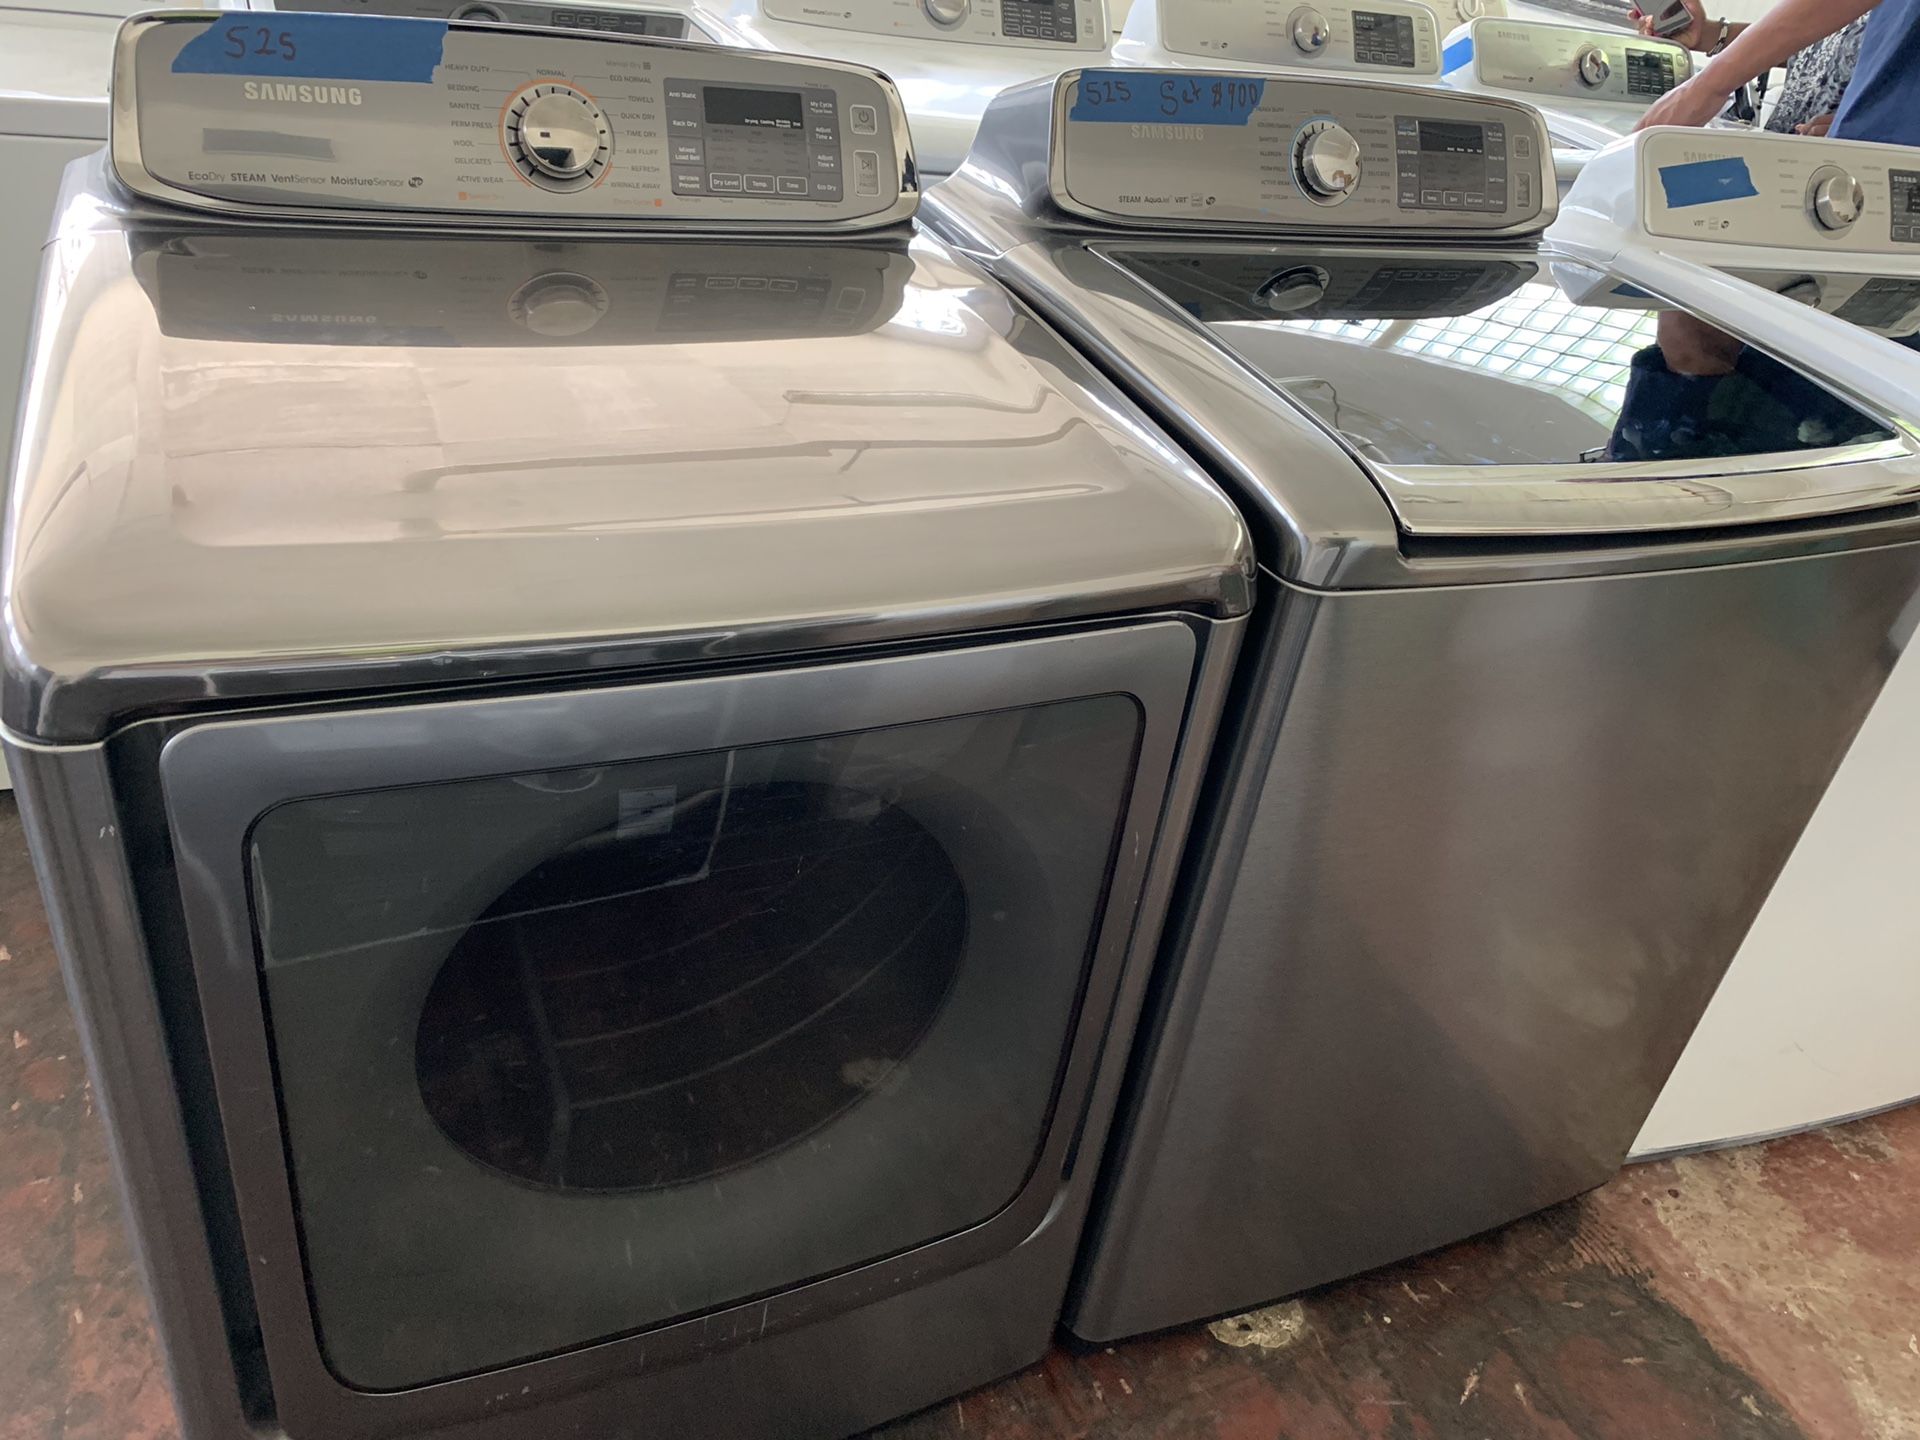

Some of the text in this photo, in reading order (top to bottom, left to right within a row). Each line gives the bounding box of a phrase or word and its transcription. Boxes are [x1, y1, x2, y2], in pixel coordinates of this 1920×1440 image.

[471, 65, 490, 73] DUTY
[536, 68, 566, 77] NORMAL
[624, 76, 652, 84] NORMAL
[448, 84, 480, 92] BEDDING
[244, 82, 362, 105] SAMSUNG
[449, 102, 480, 110] SANITIZE
[451, 120, 493, 129] PERM PRESS
[687, 120, 697, 128] Dry
[1131, 124, 1204, 140] SAMSUNG
[188, 171, 404, 187] EcoDry STEAM VentSensor MoistureSensor
[1119, 195, 1141, 203] STEAM
